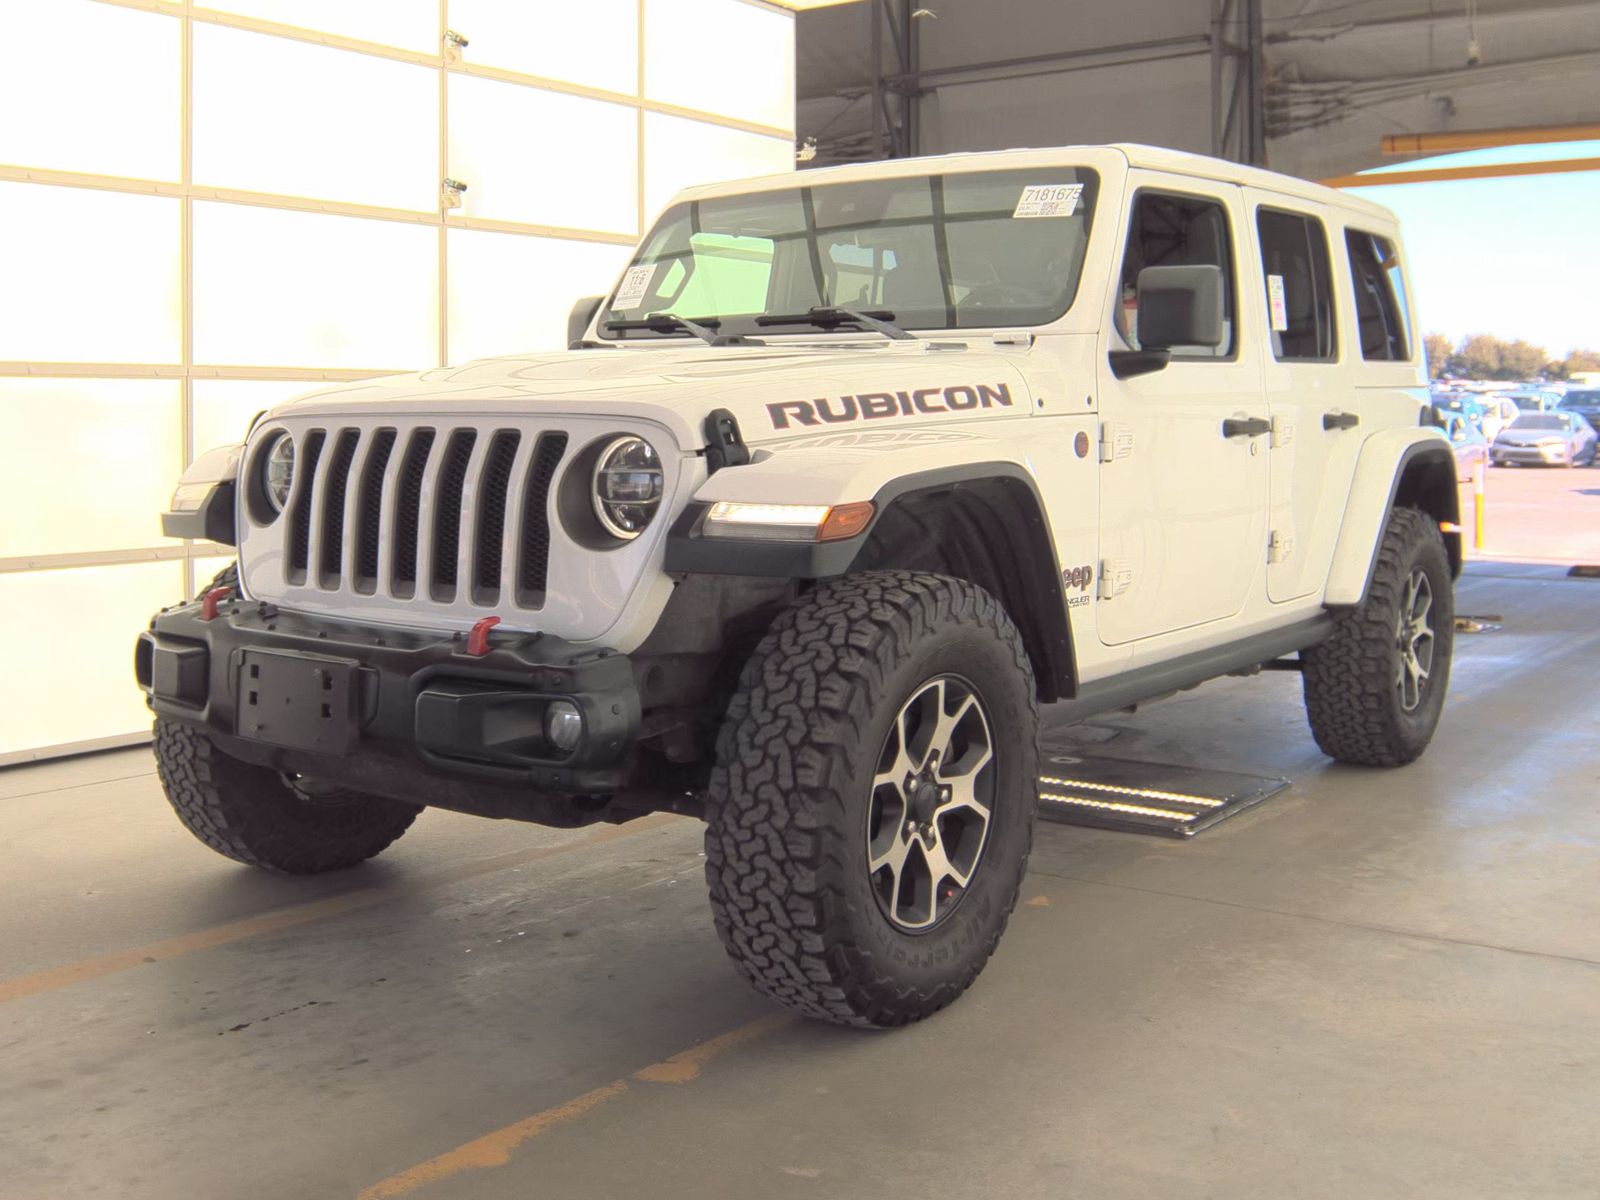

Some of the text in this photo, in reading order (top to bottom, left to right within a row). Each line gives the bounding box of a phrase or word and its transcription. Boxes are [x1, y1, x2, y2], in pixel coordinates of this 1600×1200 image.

[1024, 187, 1082, 202] 7181675
[765, 383, 1013, 430] RUBICON
[1062, 565, 1093, 591] eep
